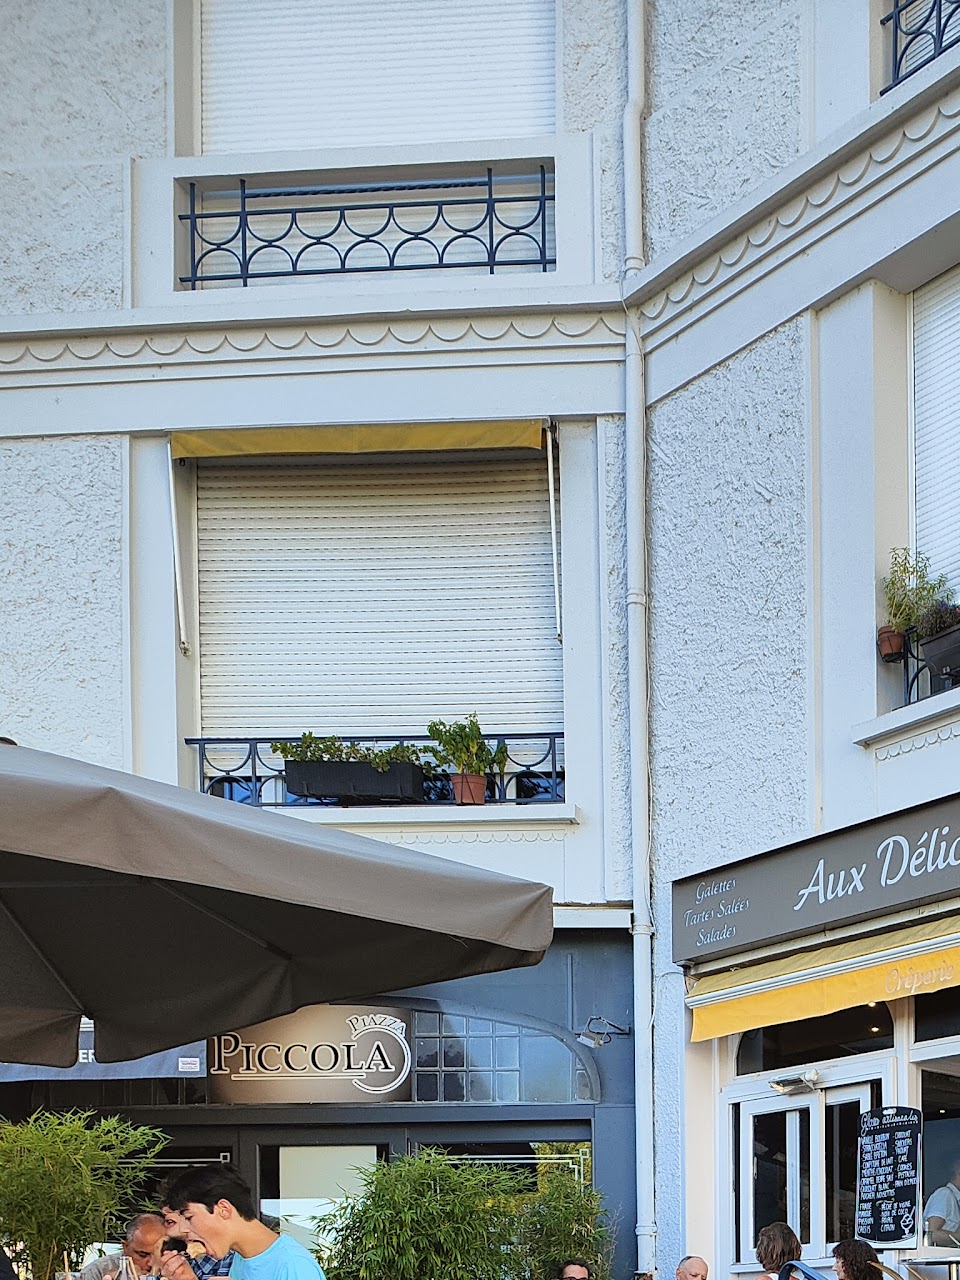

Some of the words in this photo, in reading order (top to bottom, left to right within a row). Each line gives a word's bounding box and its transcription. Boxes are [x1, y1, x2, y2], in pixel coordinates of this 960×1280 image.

[695, 877, 736, 905] Galettes
[793, 857, 868, 912] Aux
[683, 907, 714, 928] Tartes
[716, 897, 750, 918] Salées
[696, 923, 736, 947] Salades
[885, 960, 954, 994] Crêperie
[346, 1014, 406, 1036] PIAZZA
[211, 1033, 395, 1074] PICCOLA
